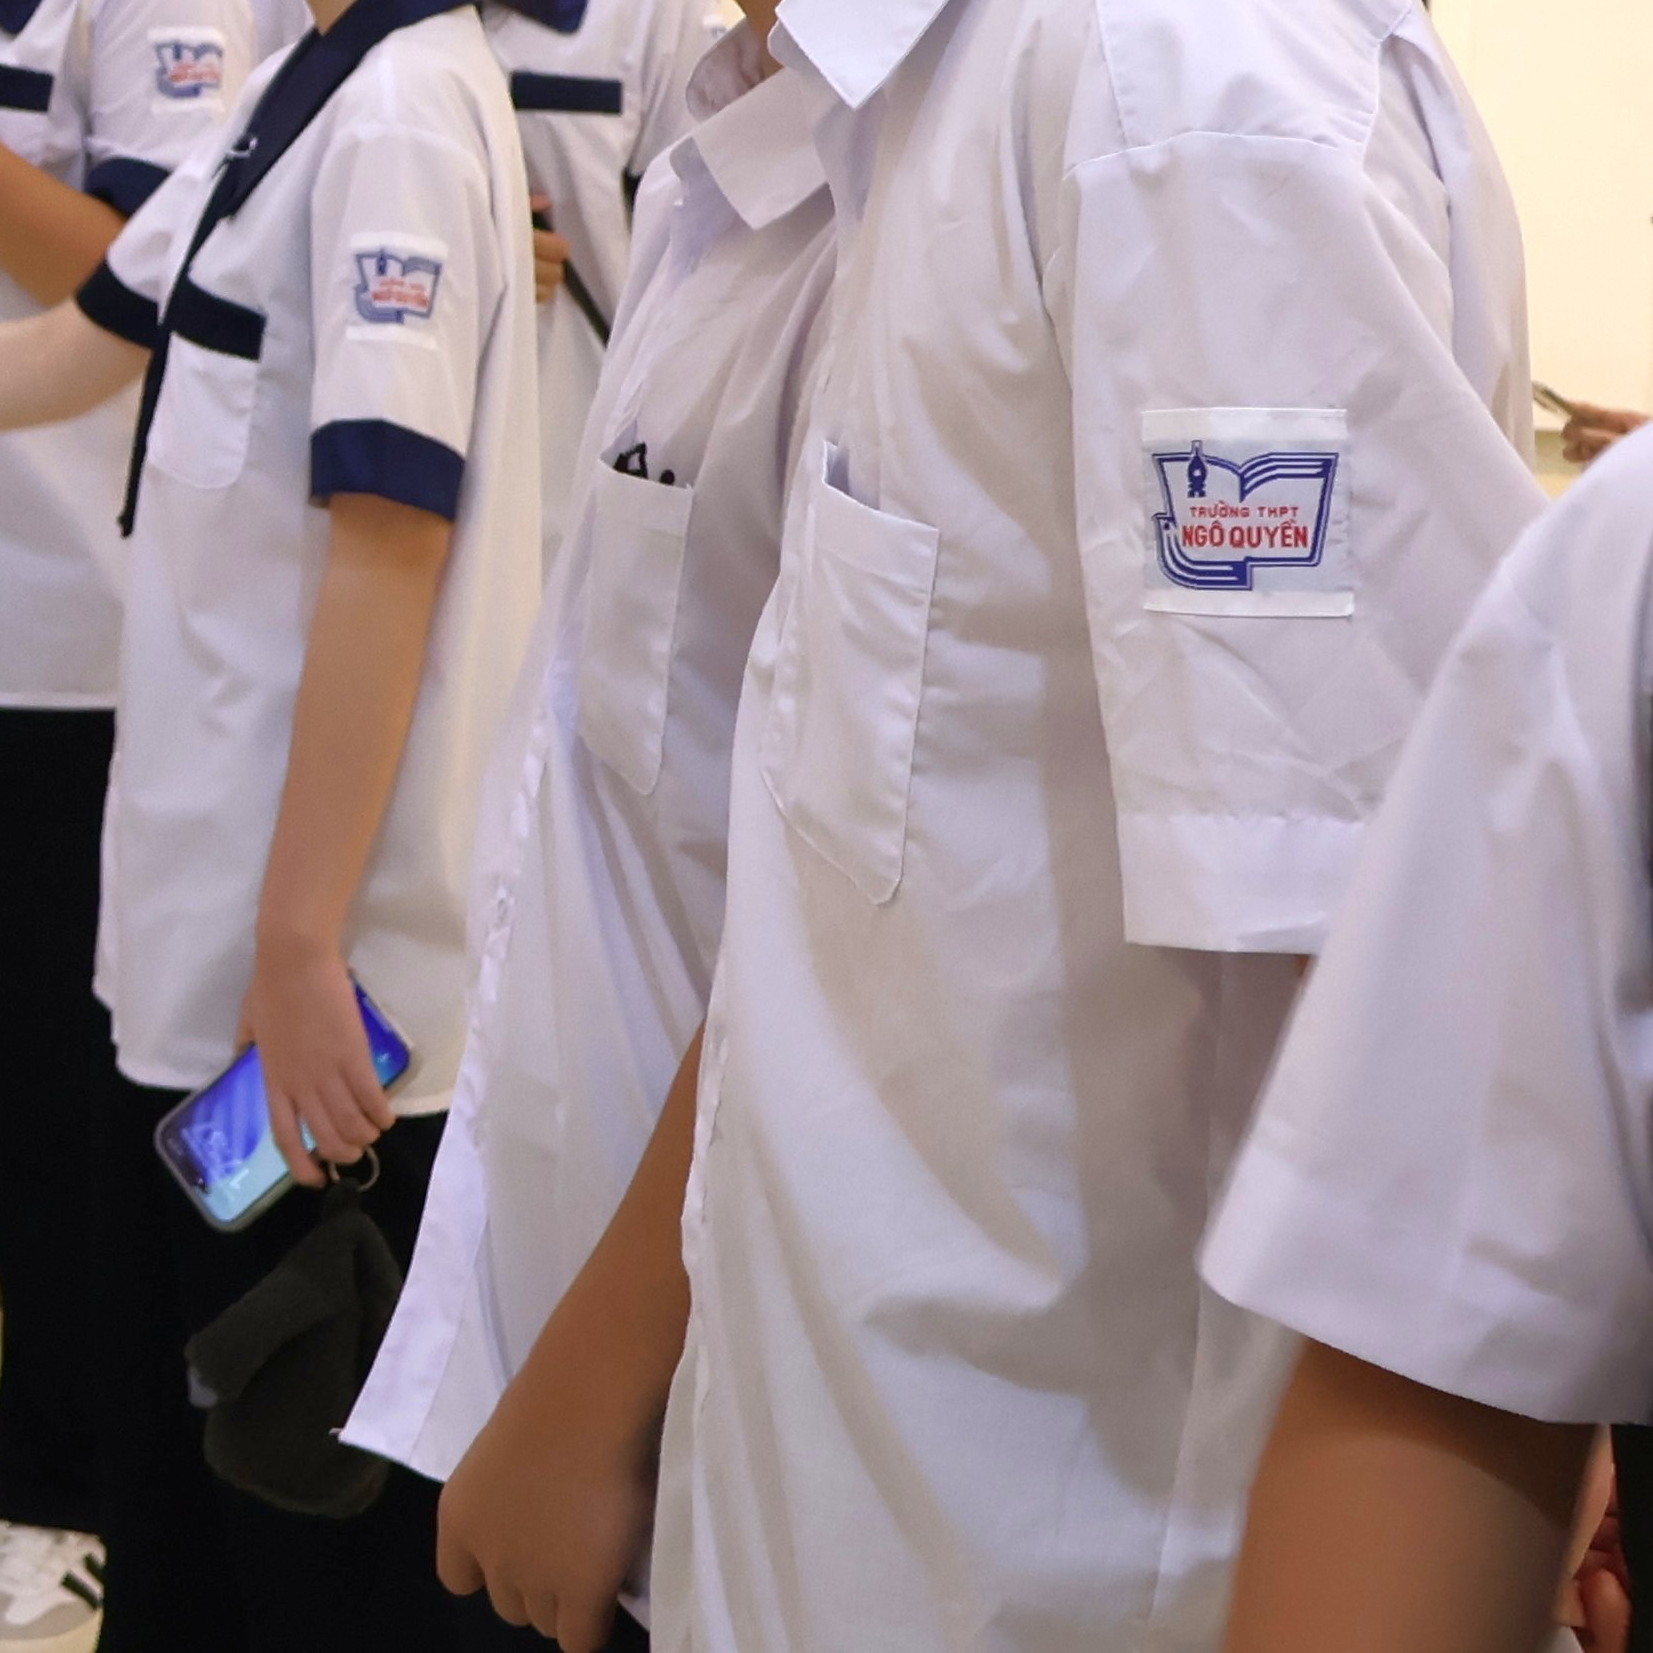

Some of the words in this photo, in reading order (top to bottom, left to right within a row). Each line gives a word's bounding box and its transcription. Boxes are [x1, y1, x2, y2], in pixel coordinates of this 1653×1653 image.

[1189, 499, 1250, 518] TRƯỜNG
[1257, 506, 1299, 518] THPT
[1182, 520, 1225, 548] NGÔ
[1229, 518, 1309, 549] QUYỀN
